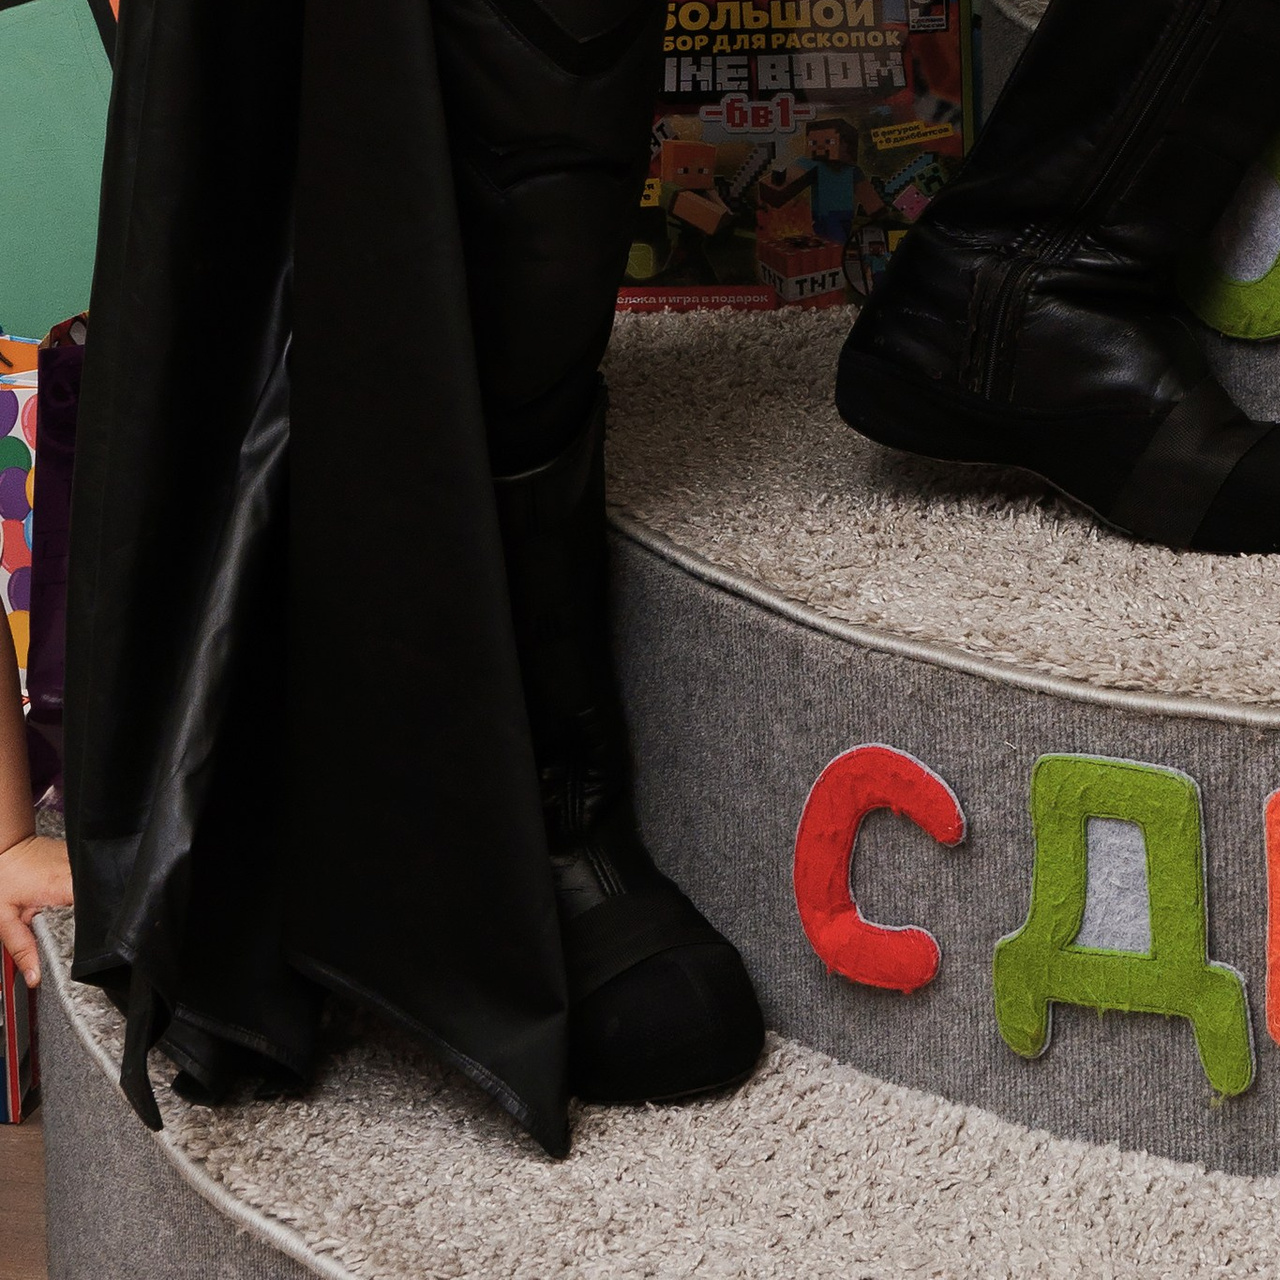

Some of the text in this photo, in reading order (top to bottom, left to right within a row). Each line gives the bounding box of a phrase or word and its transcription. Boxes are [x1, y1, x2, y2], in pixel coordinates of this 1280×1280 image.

[712, 33, 766, 54] ДЛЯ
[771, 30, 901, 50] РАСКОПОК
[711, 294, 769, 305] подарок
